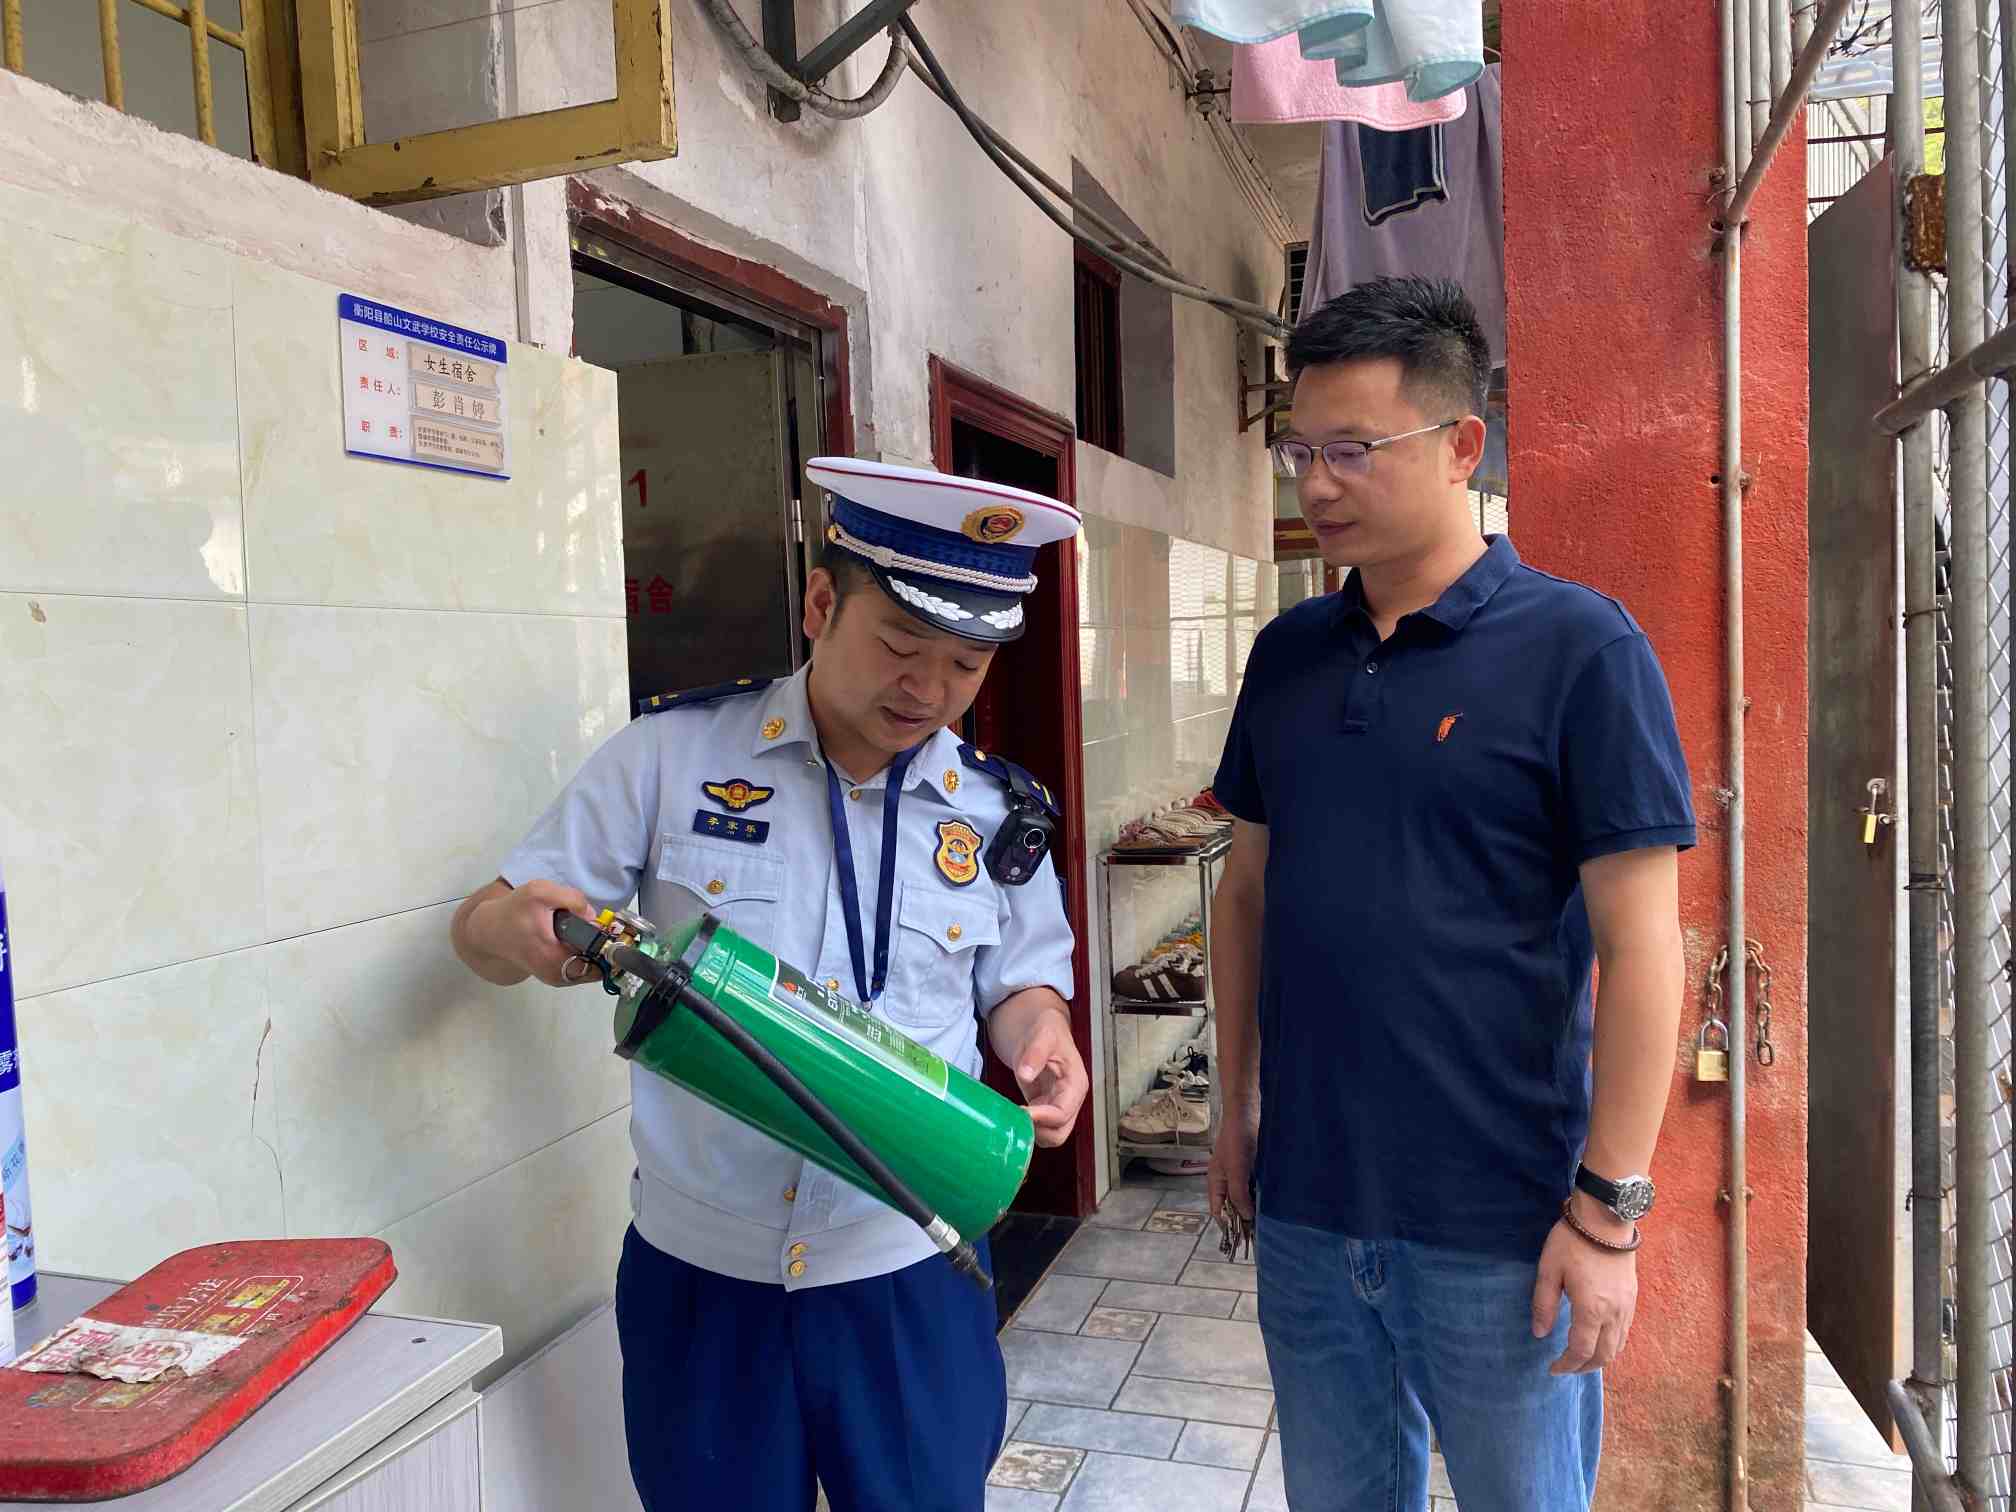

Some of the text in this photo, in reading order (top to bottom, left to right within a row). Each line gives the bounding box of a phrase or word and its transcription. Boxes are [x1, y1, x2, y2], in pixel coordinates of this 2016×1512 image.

[424, 353, 477, 383] 女生宿舍
[627, 468, 648, 507] 1
